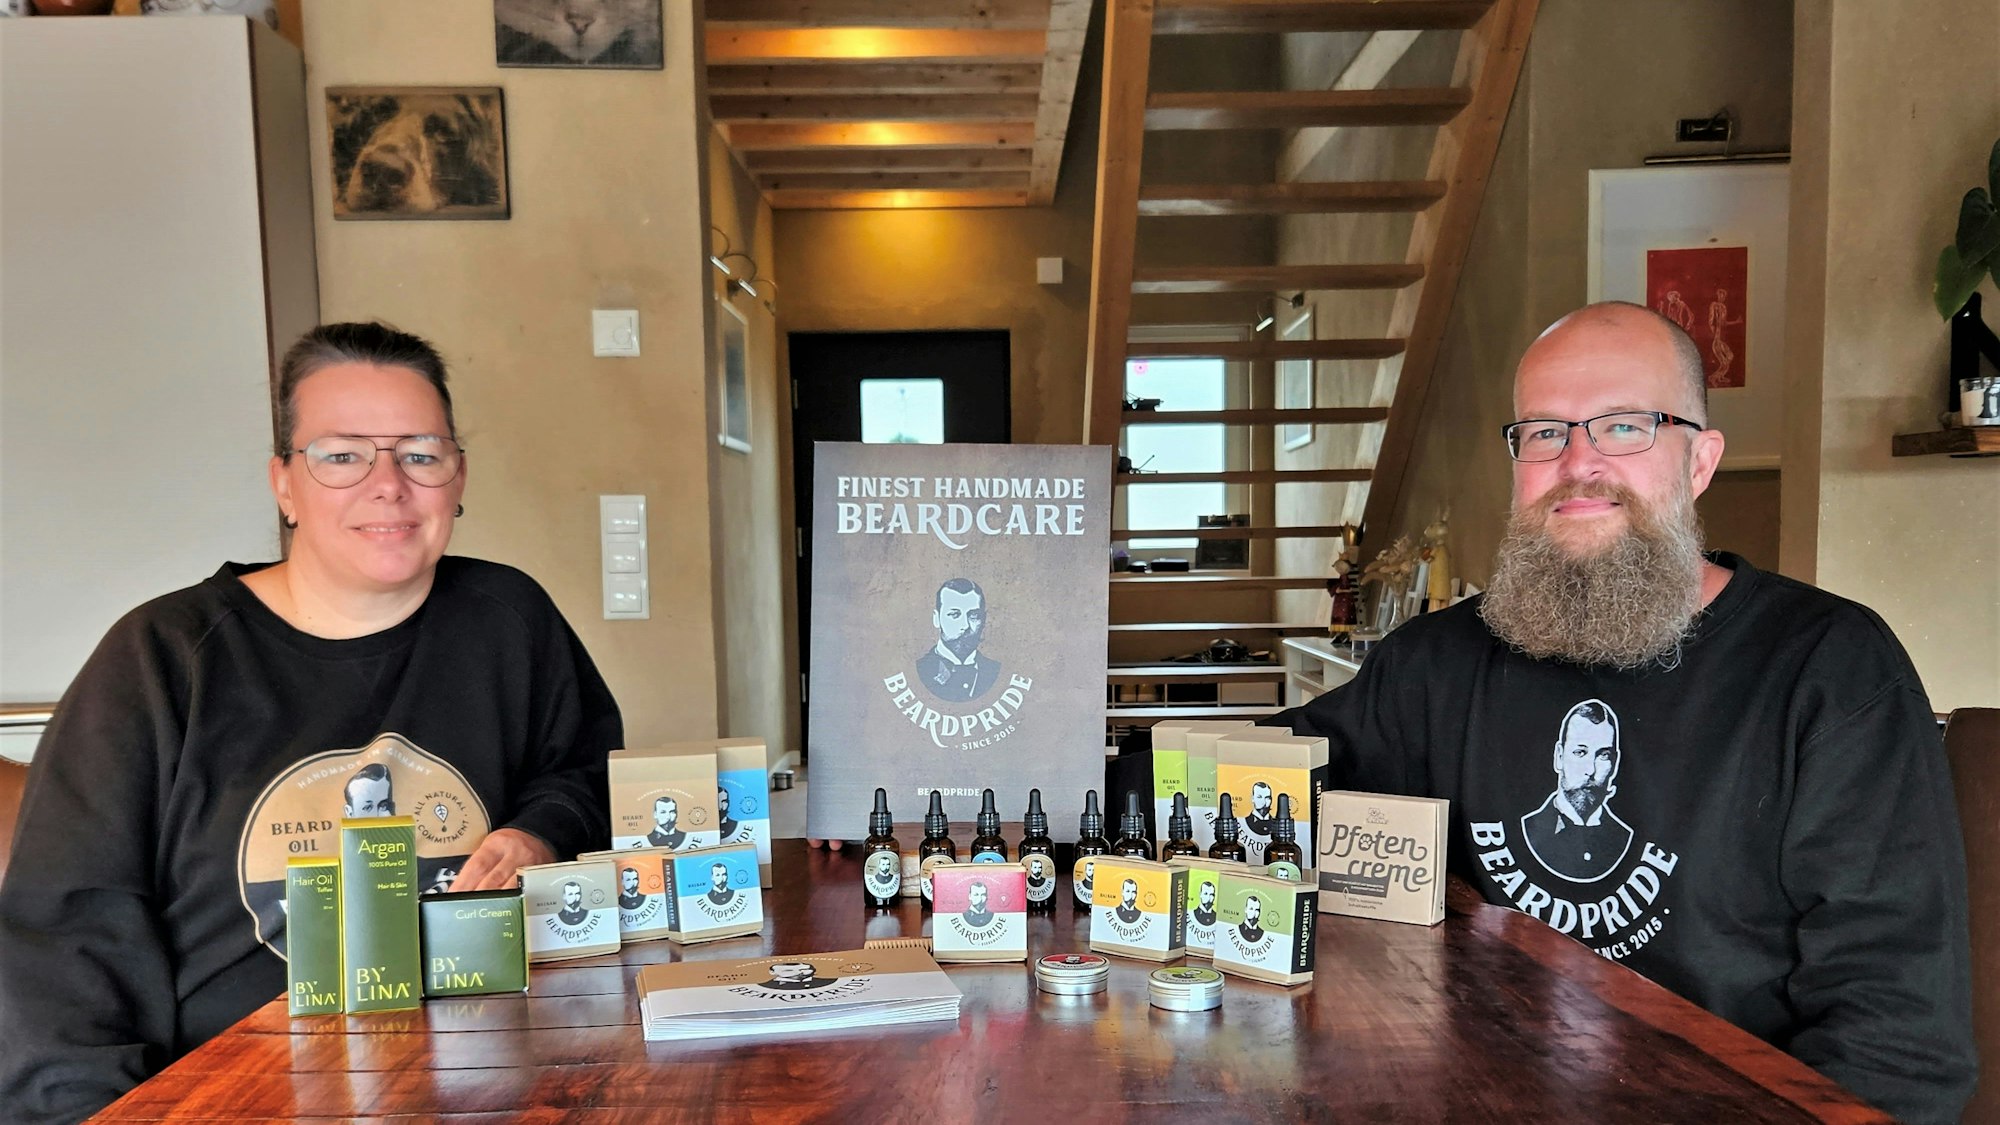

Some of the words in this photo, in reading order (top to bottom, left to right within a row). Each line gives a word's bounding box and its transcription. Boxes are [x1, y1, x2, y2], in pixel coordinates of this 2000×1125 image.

[837, 476, 925, 498] FINEST
[934, 477, 1086, 499] HANDMADE
[837, 502, 1086, 550] BEARDCARE
[884, 671, 1033, 748] BEARDPRIDE
[962, 737, 992, 751] SINCE
[994, 725, 1016, 742] 2015
[414, 801, 426, 816] ALL
[425, 791, 466, 811] NATURAL
[271, 820, 333, 836] BEARD
[418, 820, 469, 844] COMMITMENT
[288, 839, 319, 853] OIL
[358, 839, 406, 859] Argan
[1320, 824, 1428, 861] Pfoten
[293, 876, 315, 886] Hair
[316, 874, 333, 885] Oil
[1347, 860, 1432, 893] creme
[1470, 821, 1679, 939] BEARDPRIDE
[455, 909, 476, 920] Curl
[479, 908, 512, 918] Cream
[697, 893, 746, 922] BEARDPRIDE
[546, 913, 602, 943] BEARDPRIDE
[951, 916, 1006, 946] BEARDPRIDE
[1105, 911, 1152, 941] BEARDPRIDE
[1300, 899, 1310, 967] BEARDPRIDE
[1629, 916, 1663, 950] 2015
[1228, 928, 1275, 960] BEARDPRIDE
[356, 966, 386, 984] BY
[432, 957, 460, 973] BY
[295, 981, 318, 994] BY
[357, 983, 411, 1002] LINA
[433, 972, 484, 990] LINA
[728, 978, 871, 1002] BEARDPRIDE
[295, 993, 336, 1007] LINA
